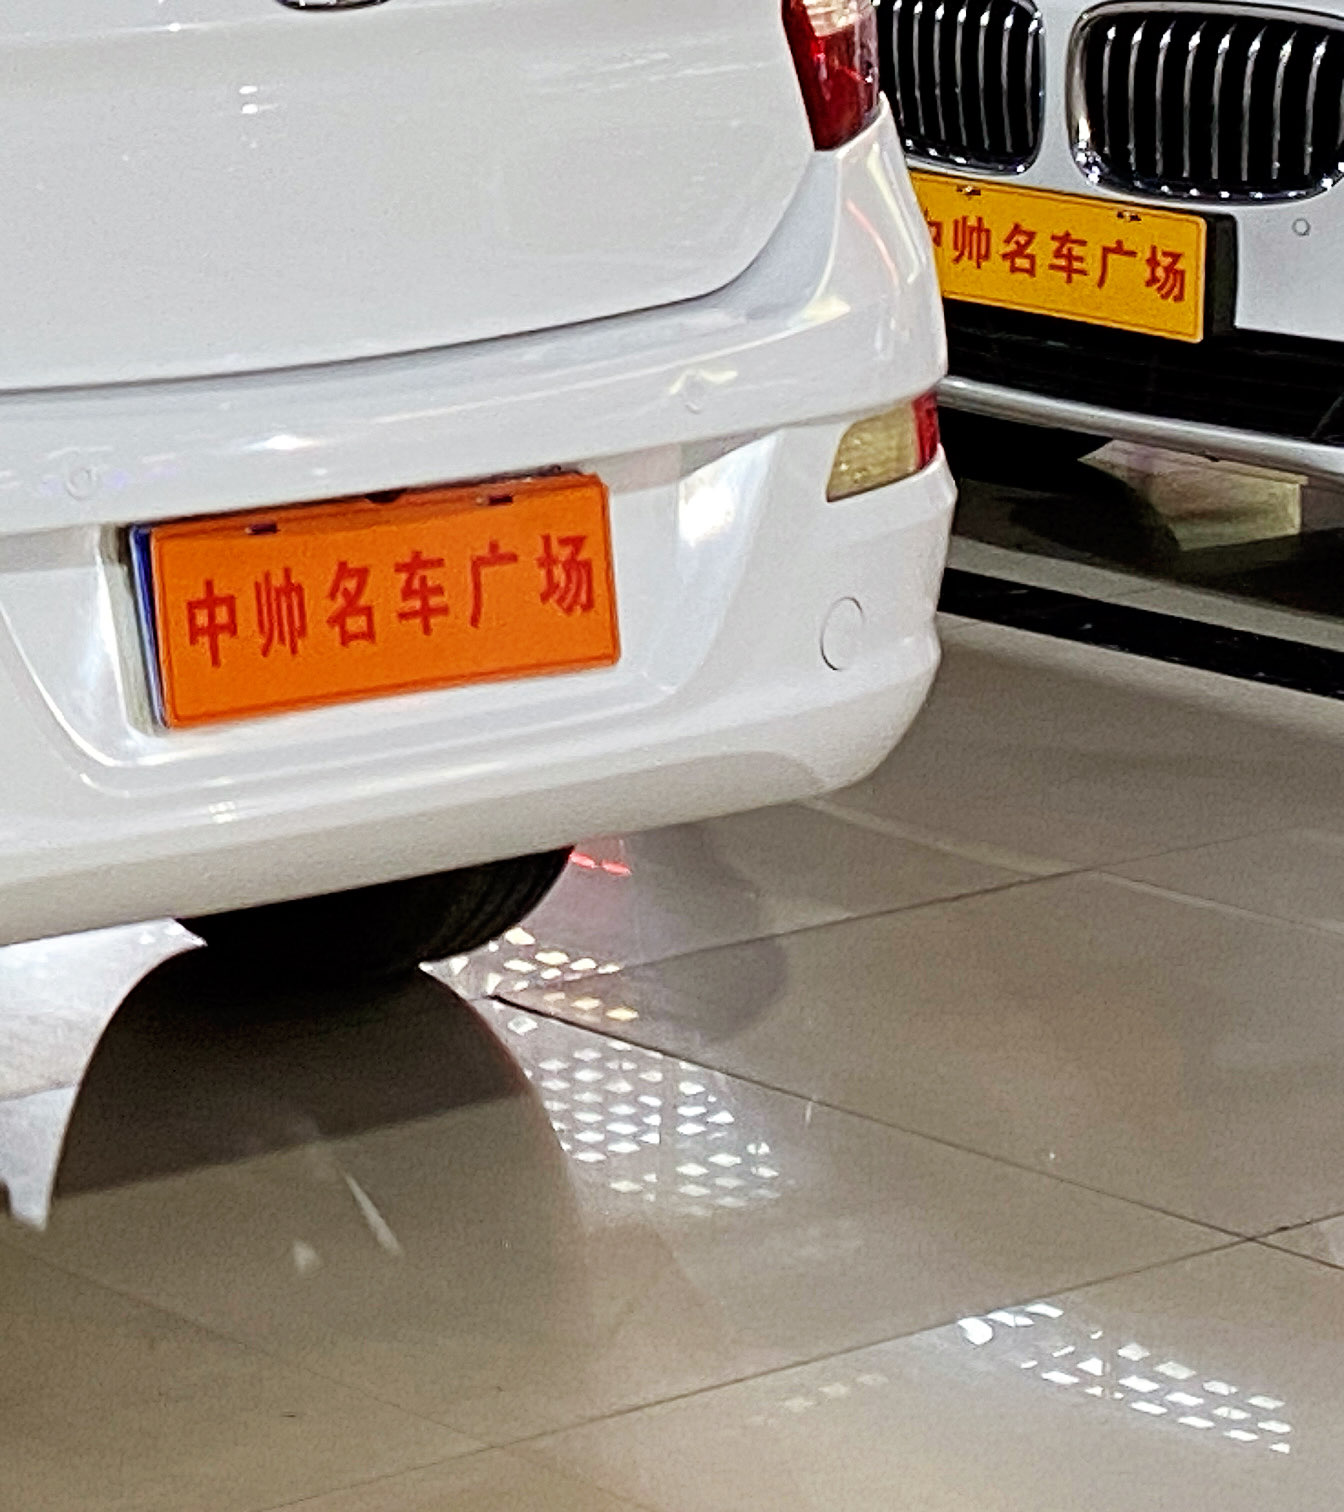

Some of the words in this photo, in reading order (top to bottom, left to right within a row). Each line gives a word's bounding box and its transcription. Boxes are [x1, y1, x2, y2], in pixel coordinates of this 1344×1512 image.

[185, 533, 595, 668] 中帅名车广场
